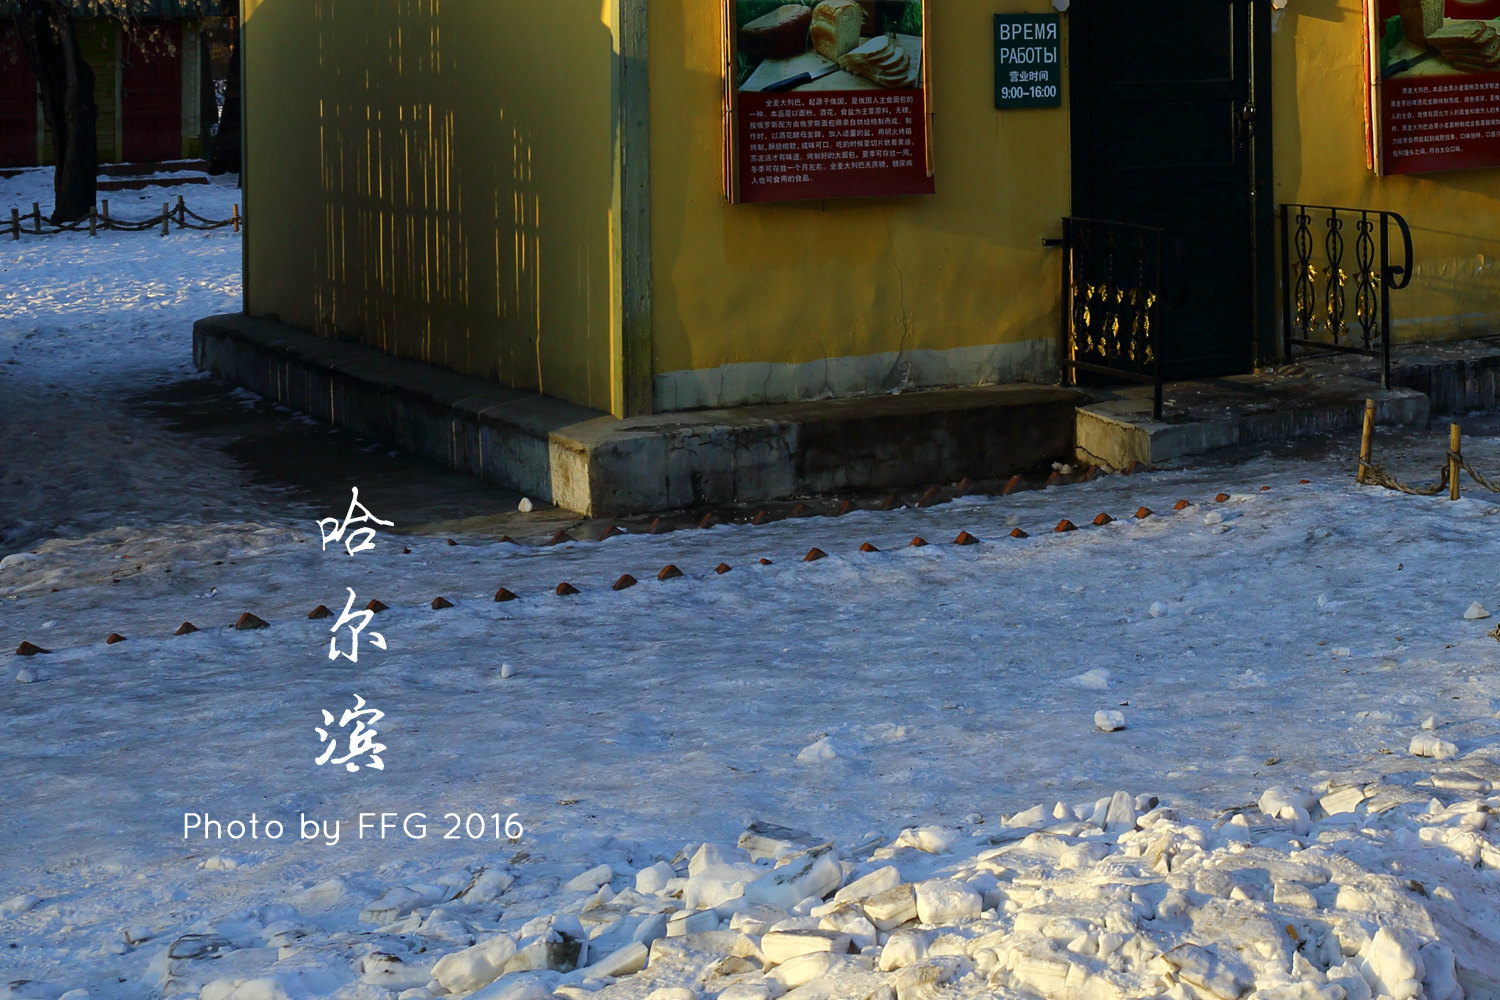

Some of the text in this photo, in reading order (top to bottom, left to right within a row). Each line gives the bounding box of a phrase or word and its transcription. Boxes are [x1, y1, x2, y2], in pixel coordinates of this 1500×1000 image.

[1000, 23, 1057, 40] ВРЕМЯ
[1000, 46, 1057, 64] РАБОТЫ
[1009, 70, 1049, 82] 营业时间
[1001, 85, 1057, 99] 9:00-16:00
